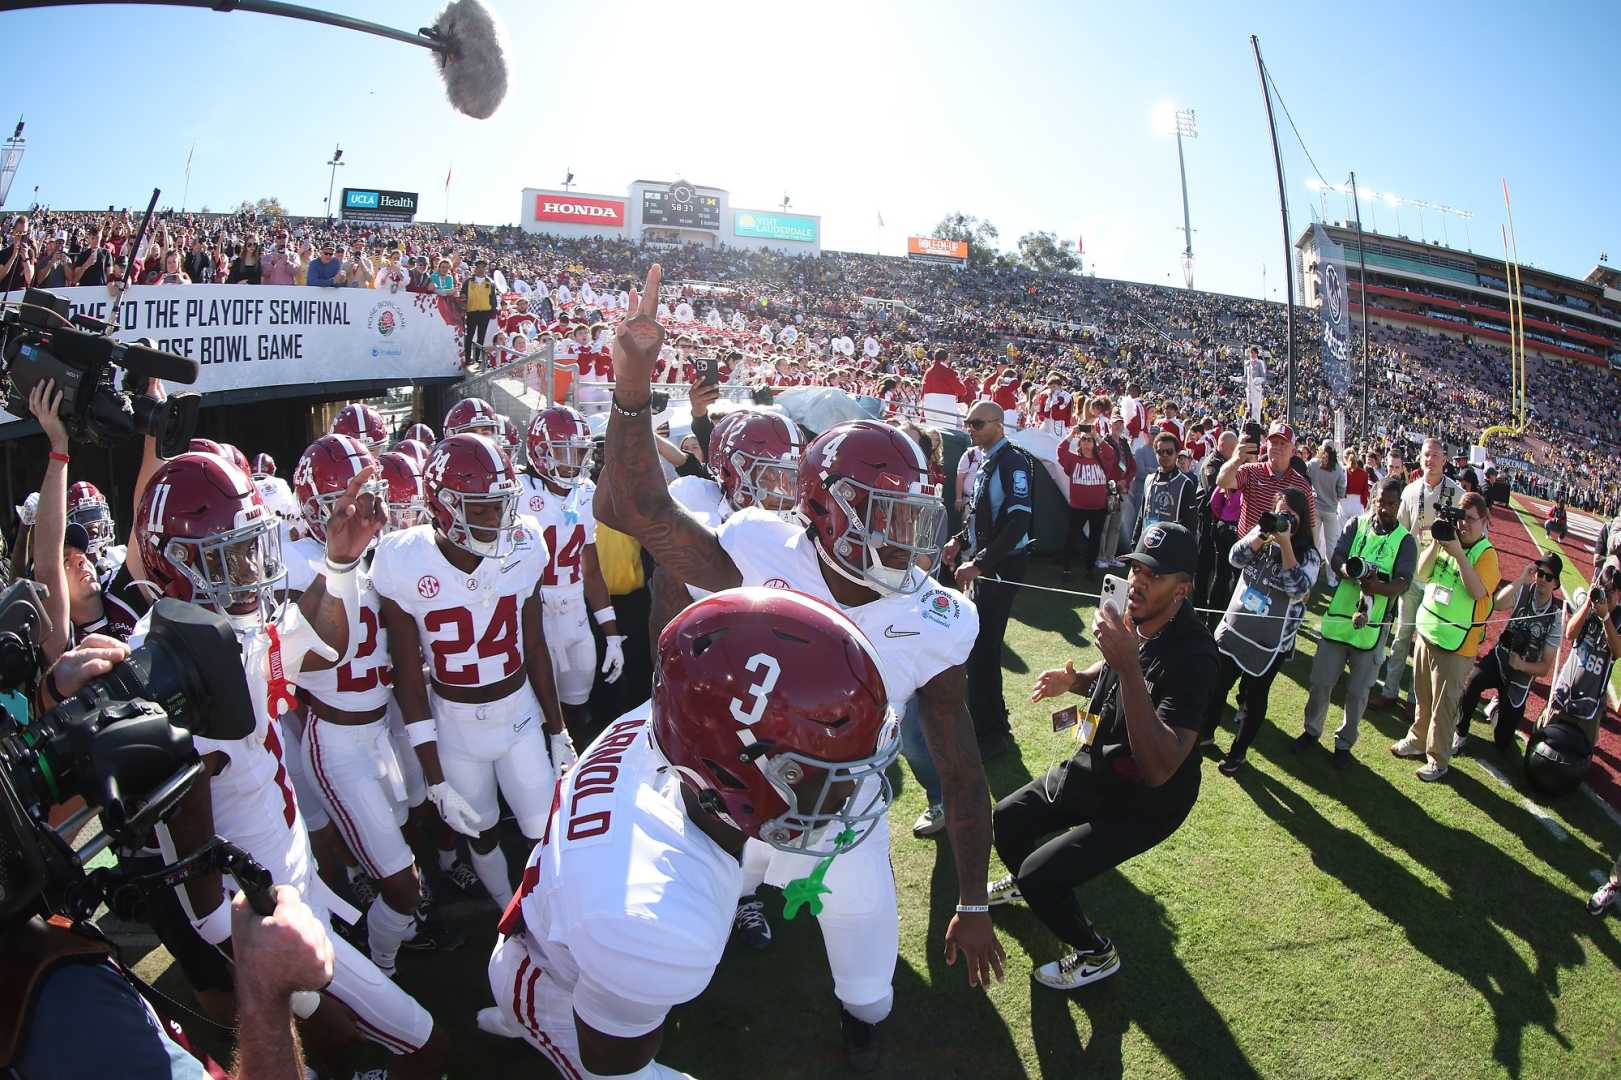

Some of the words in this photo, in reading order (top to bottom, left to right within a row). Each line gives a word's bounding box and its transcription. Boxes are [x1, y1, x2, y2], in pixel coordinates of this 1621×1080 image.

[351, 194, 374, 205] UCLA
[380, 195, 413, 208] Health
[543, 202, 617, 218] HONDA
[145, 299, 180, 328] THE
[186, 298, 263, 328] PLAYOFF
[269, 299, 350, 326] SEMIFINAL
[201, 335, 252, 364] BOWL
[258, 334, 303, 361] GAME
[424, 449, 451, 482] 24
[821, 433, 848, 468] 4
[147, 483, 172, 534] 11
[542, 523, 586, 586] 14
[418, 576, 440, 598] SEC
[423, 594, 524, 685] 24
[1585, 654, 1604, 676] 66
[729, 652, 782, 726] 3
[566, 719, 647, 841] ARNOLD
